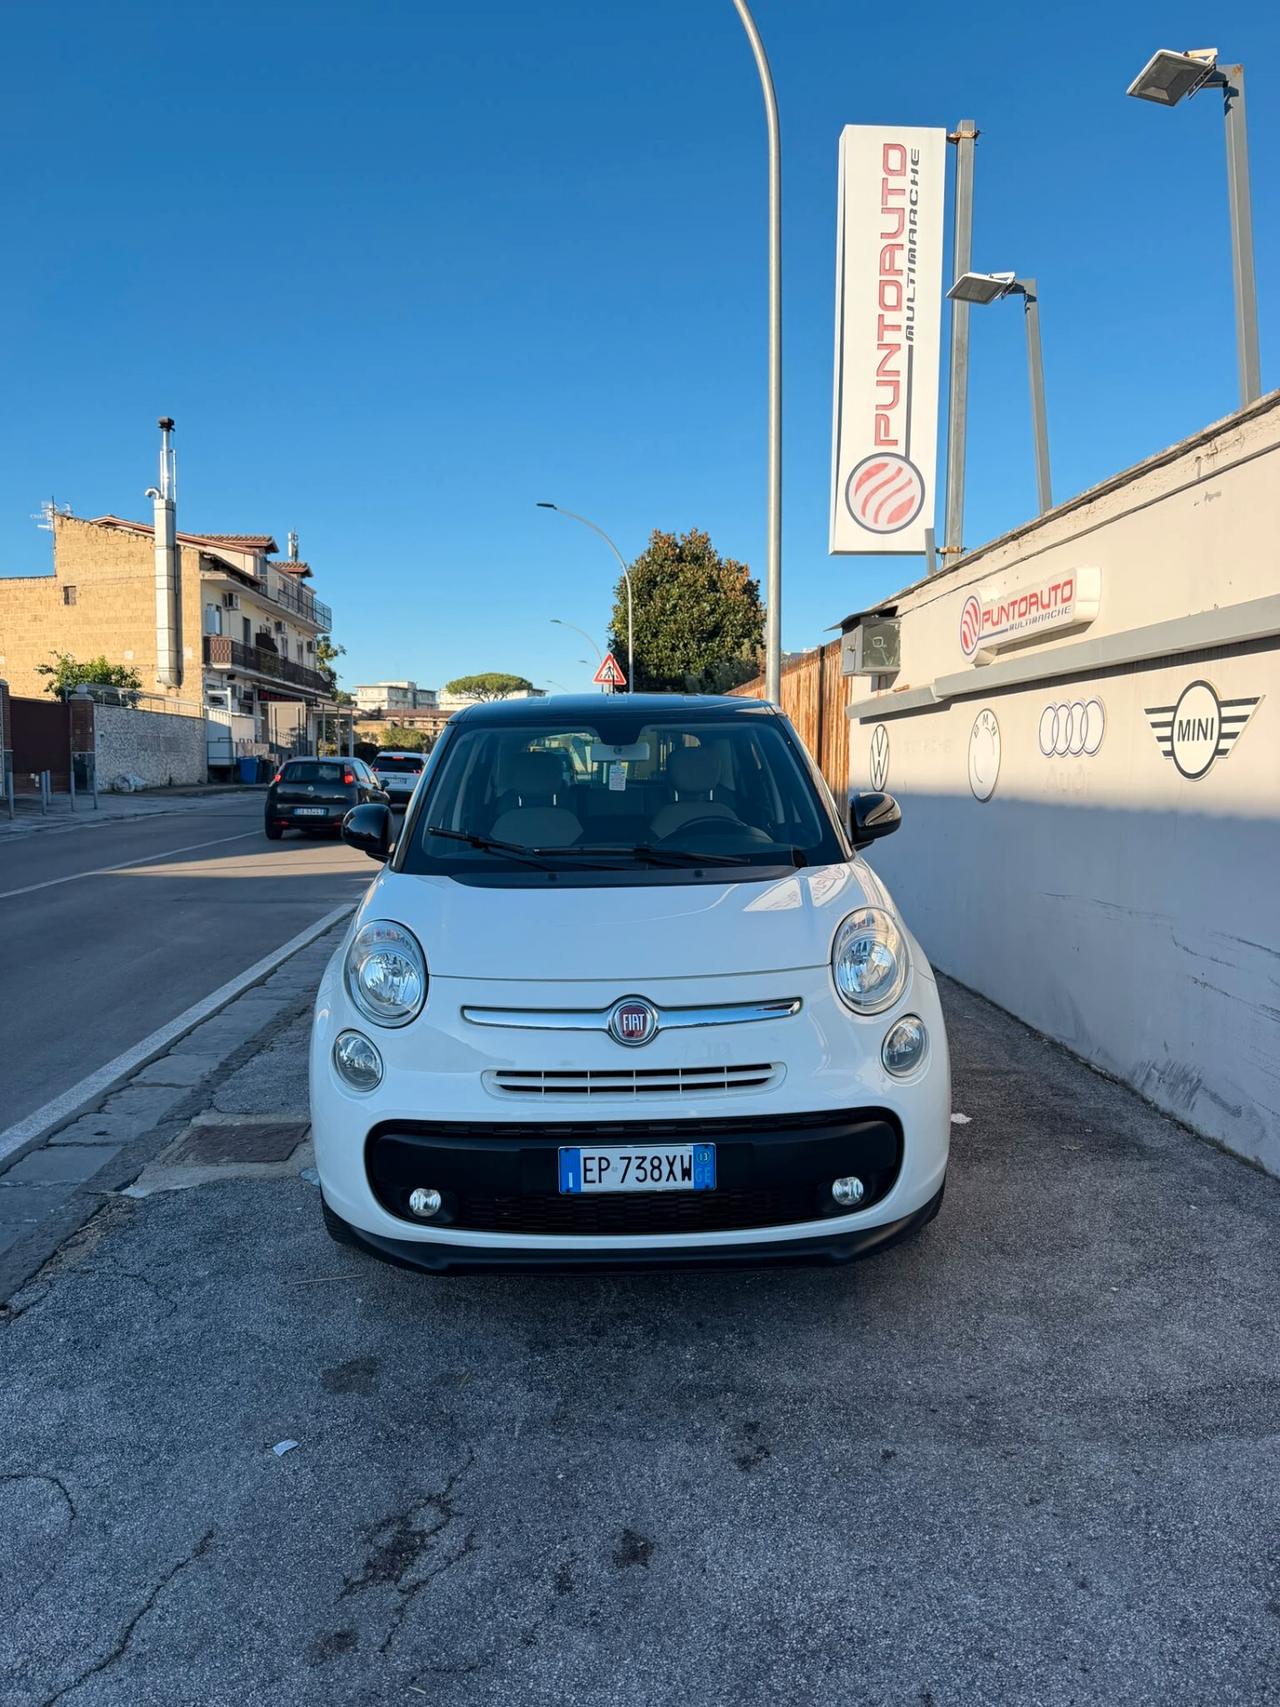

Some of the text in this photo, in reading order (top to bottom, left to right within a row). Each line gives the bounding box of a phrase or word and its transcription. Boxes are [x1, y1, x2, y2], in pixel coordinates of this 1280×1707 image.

[905, 147, 920, 342] MULTIMARCHE
[874, 142, 907, 446] PUNTOAUTO
[981, 578, 1073, 630] PUNTOAUTO
[1177, 716, 1215, 743] MINI
[622, 1013, 645, 1031] FIAT
[583, 1154, 692, 1184] EP 738XW
